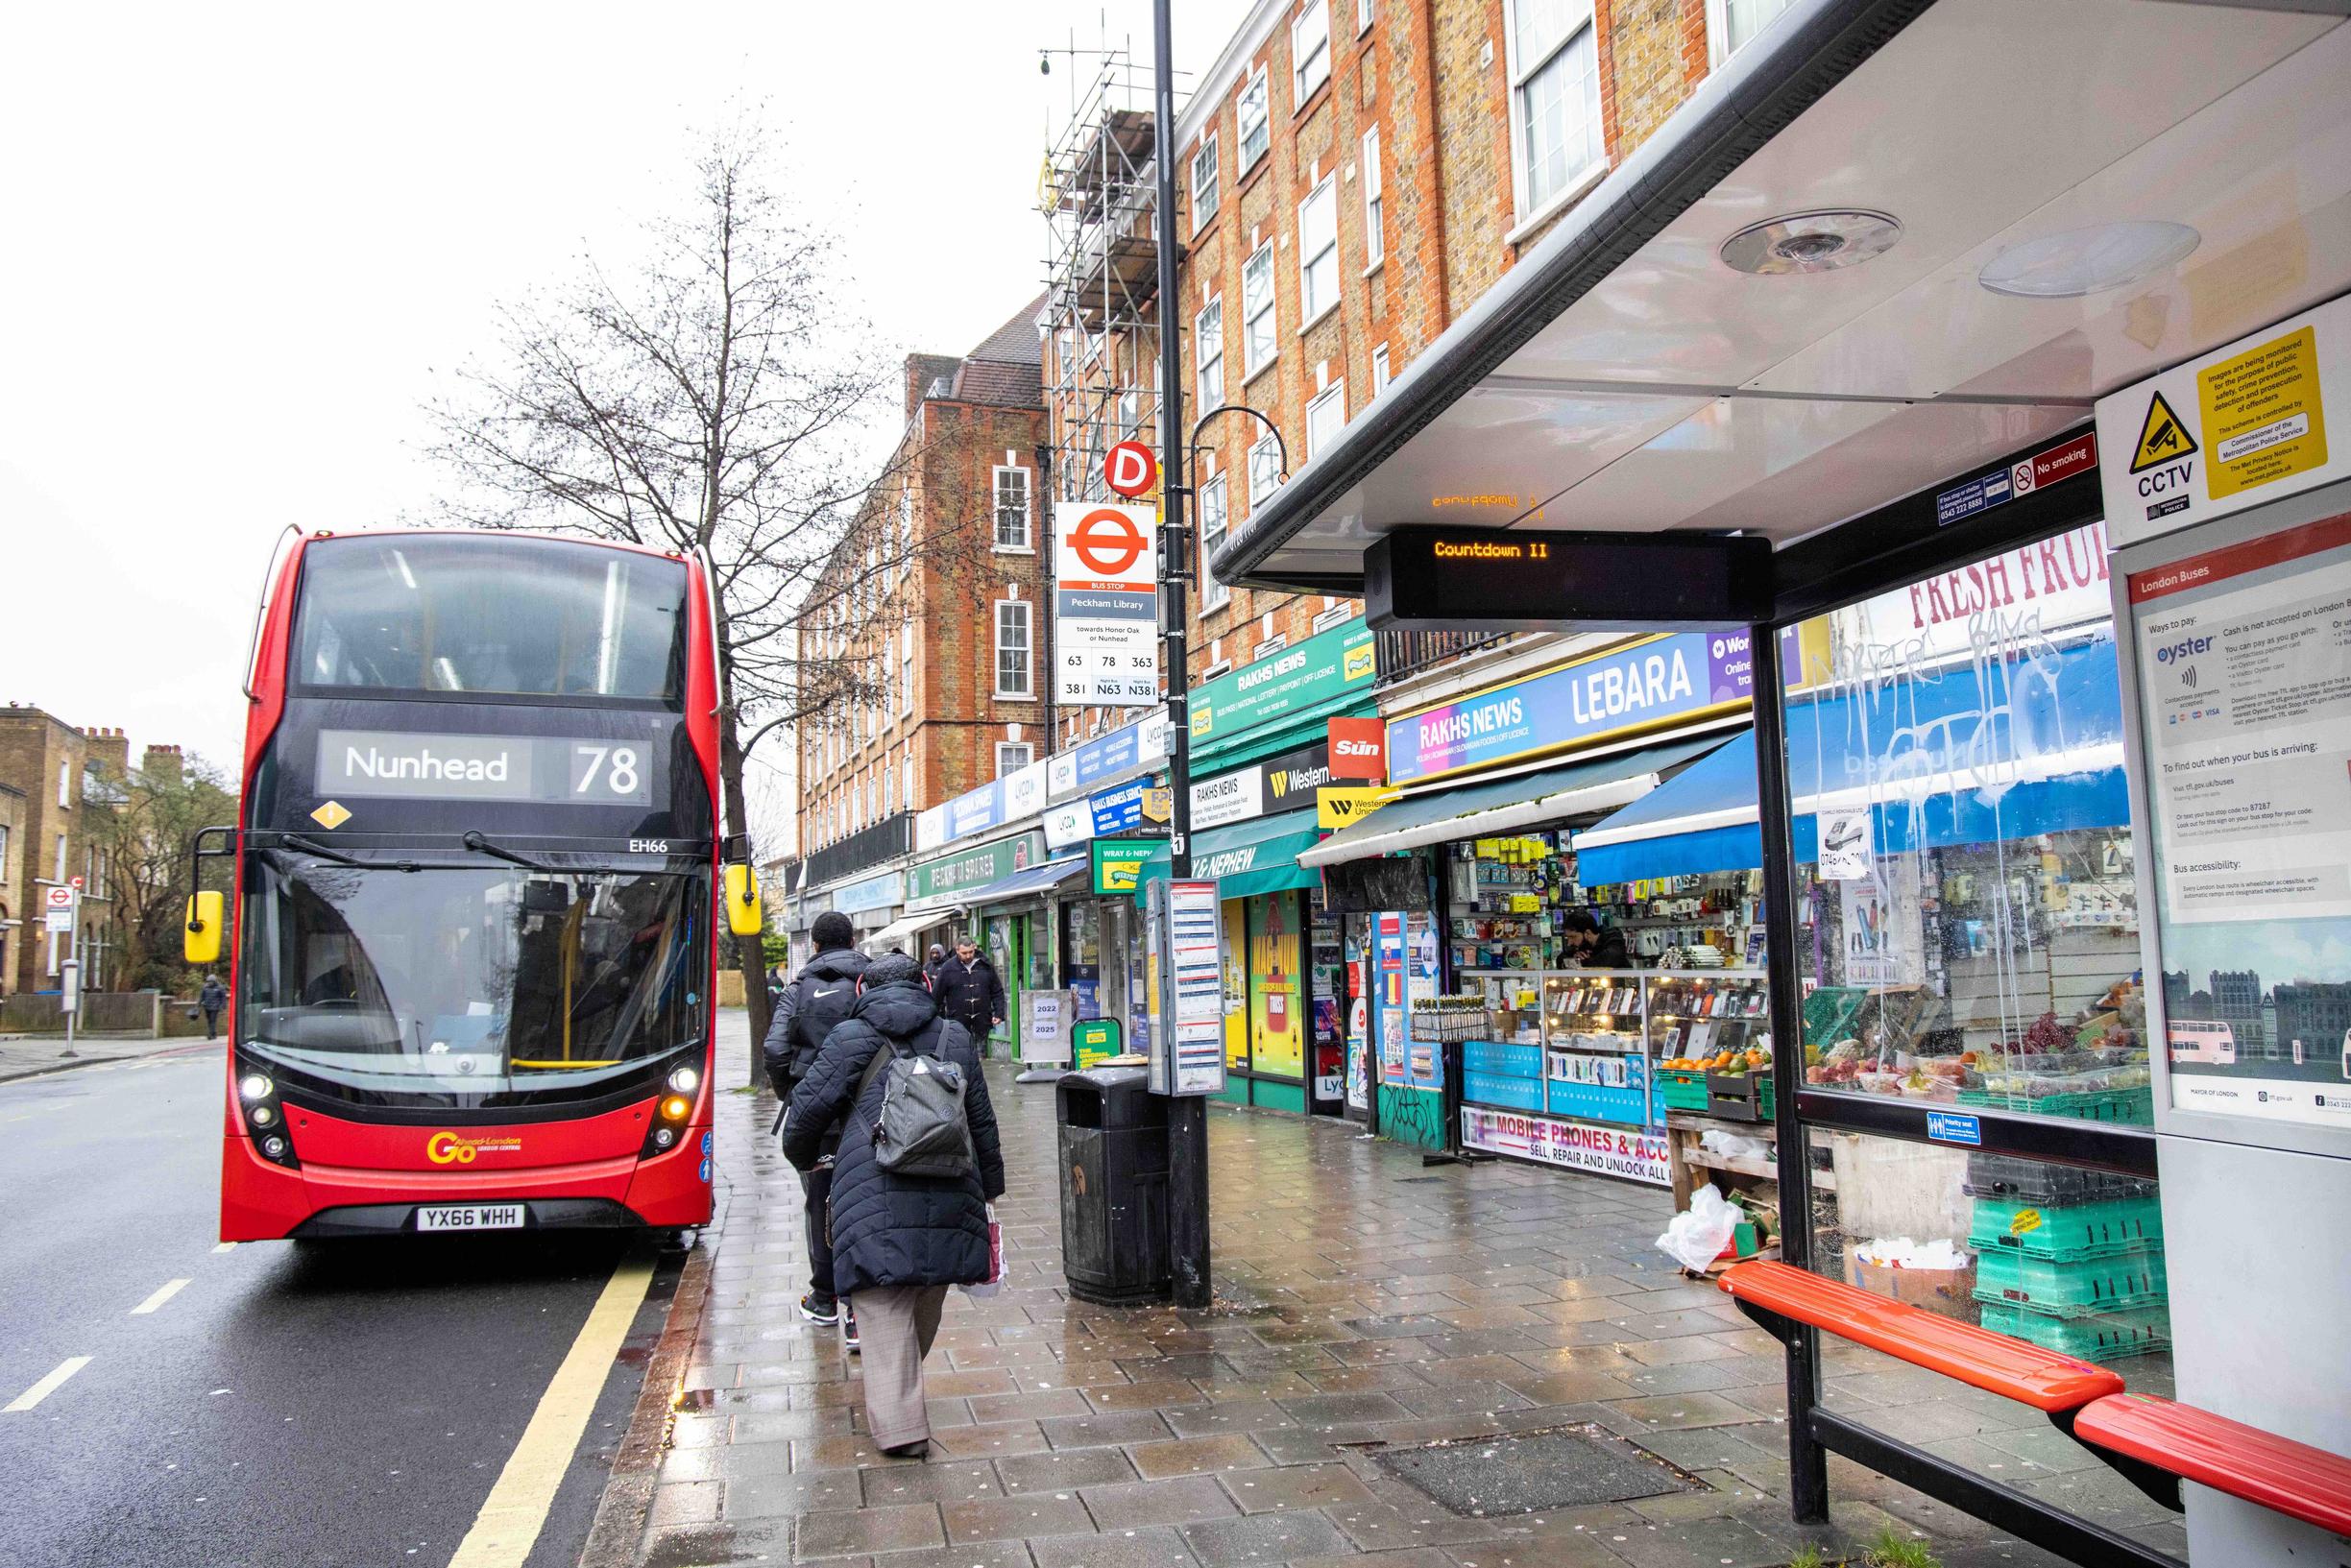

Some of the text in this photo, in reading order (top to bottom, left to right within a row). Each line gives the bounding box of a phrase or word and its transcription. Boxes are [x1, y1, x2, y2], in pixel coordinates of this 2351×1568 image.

[2208, 339, 2302, 382] Images are being monitored
[2214, 382, 2224, 391] for
[2237, 367, 2266, 385] purpose
[2275, 353, 2298, 368] public
[2214, 373, 2302, 411] detection and prosecution
[2238, 380, 2257, 392] crime
[2259, 365, 2298, 384] prevention,
[2237, 394, 2279, 413] of offenders
[2218, 425, 2232, 435] This
[2233, 419, 2255, 430] scheme
[2263, 404, 2293, 421] controlled
[2293, 400, 2303, 410] by
[2222, 426, 2303, 459] Metropolitan Police Service
[2231, 428, 2273, 446] Commissioner
[1113, 447, 1147, 488] D
[2037, 448, 2086, 475] No smoking
[2139, 461, 2192, 497] CCTV
[2241, 466, 2292, 486] www.met.police.uk
[1941, 497, 1982, 519] 0343 222 8888
[2165, 503, 2184, 513] POLICE
[1435, 542, 1521, 557] Countdown
[1909, 555, 2015, 628] FRESH
[2142, 566, 2209, 592] London Buses
[1072, 598, 1143, 611] Peckham Library
[2149, 616, 2197, 635] Ways to pay:
[2223, 626, 2242, 637] Cash
[2251, 621, 2265, 630] not
[2266, 613, 2300, 627] accepted
[2302, 609, 2312, 618] on
[2314, 602, 2344, 615] London
[2157, 636, 2213, 665] oyster
[2240, 642, 2251, 651] can
[2253, 639, 2265, 650] pay
[2276, 635, 2289, 644] you
[2290, 632, 2298, 640] go
[2301, 627, 2318, 636] with:
[1068, 656, 1151, 667] 63 78 363
[1238, 650, 1306, 691] RAKHS NEWS
[1725, 662, 1751, 676] Online
[1066, 684, 1155, 695] 381 N63 N381
[1217, 707, 1226, 717] BUS
[1226, 703, 1236, 715] PASS
[1238, 696, 1257, 712] NATIONAL
[1257, 687, 1277, 704] LOTTERY
[1280, 678, 1301, 697] PAYPOINT
[1304, 673, 1315, 685] OFF
[1315, 664, 1336, 681] LICENCE
[1571, 648, 1692, 724] LEBARA
[1420, 697, 1522, 749] RAKHS NEWS
[2205, 708, 2219, 716] VISA
[1416, 754, 1431, 763] POLISH
[1433, 747, 1454, 760] ROMANIAN
[1456, 743, 1480, 754] SLOVAKIAN
[1481, 737, 1496, 747] FOODS
[1509, 727, 1529, 739] LICENCE
[2164, 742, 2317, 773] To find out when your bus is arriving:
[346, 746, 508, 782] Nunhead
[575, 747, 639, 794] 78
[1197, 779, 1238, 802] RAKHS NEWS
[1289, 766, 1329, 791] Western
[2186, 778, 2234, 791] tfl.gov.uk/buses
[628, 840, 667, 853] EH66
[1175, 840, 1180, 854] 1
[932, 853, 994, 889] PECKHAM SPARES
[1200, 847, 1257, 877] & NEPHEW
[2174, 860, 2241, 874] Bus accessibility:
[72, 878, 82, 886] C
[1496, 1116, 1546, 1141] MOBILE
[1551, 1123, 1612, 1152] PHONES
[1618, 1135, 1629, 1155] &
[1945, 1119, 1961, 1127] Priority
[427, 1131, 476, 1164] Go
[1530, 1145, 1665, 1181] SELL, REPAIR AND UNLOCK ALL
[427, 1208, 516, 1226] YX66 WHH
